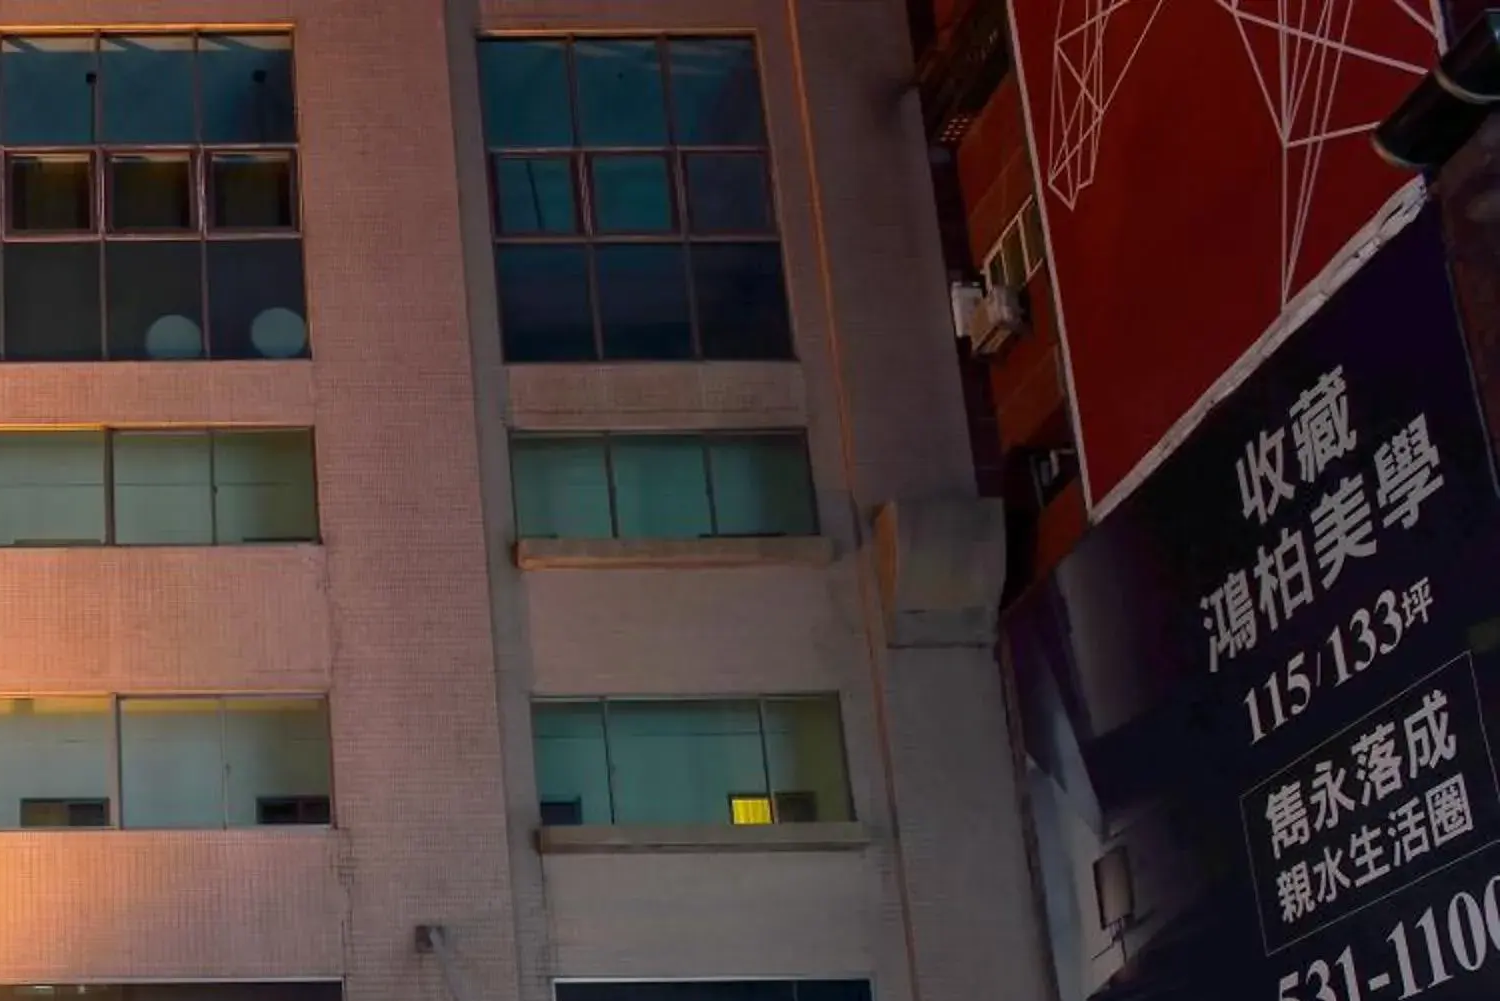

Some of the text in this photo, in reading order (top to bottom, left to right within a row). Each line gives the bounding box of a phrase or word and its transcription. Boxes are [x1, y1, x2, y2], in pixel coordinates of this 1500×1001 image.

[1235, 364, 1358, 525] 收藏
[1199, 412, 1445, 673] 鴻柏美學
[1275, 772, 1474, 924] 親水生活圈
